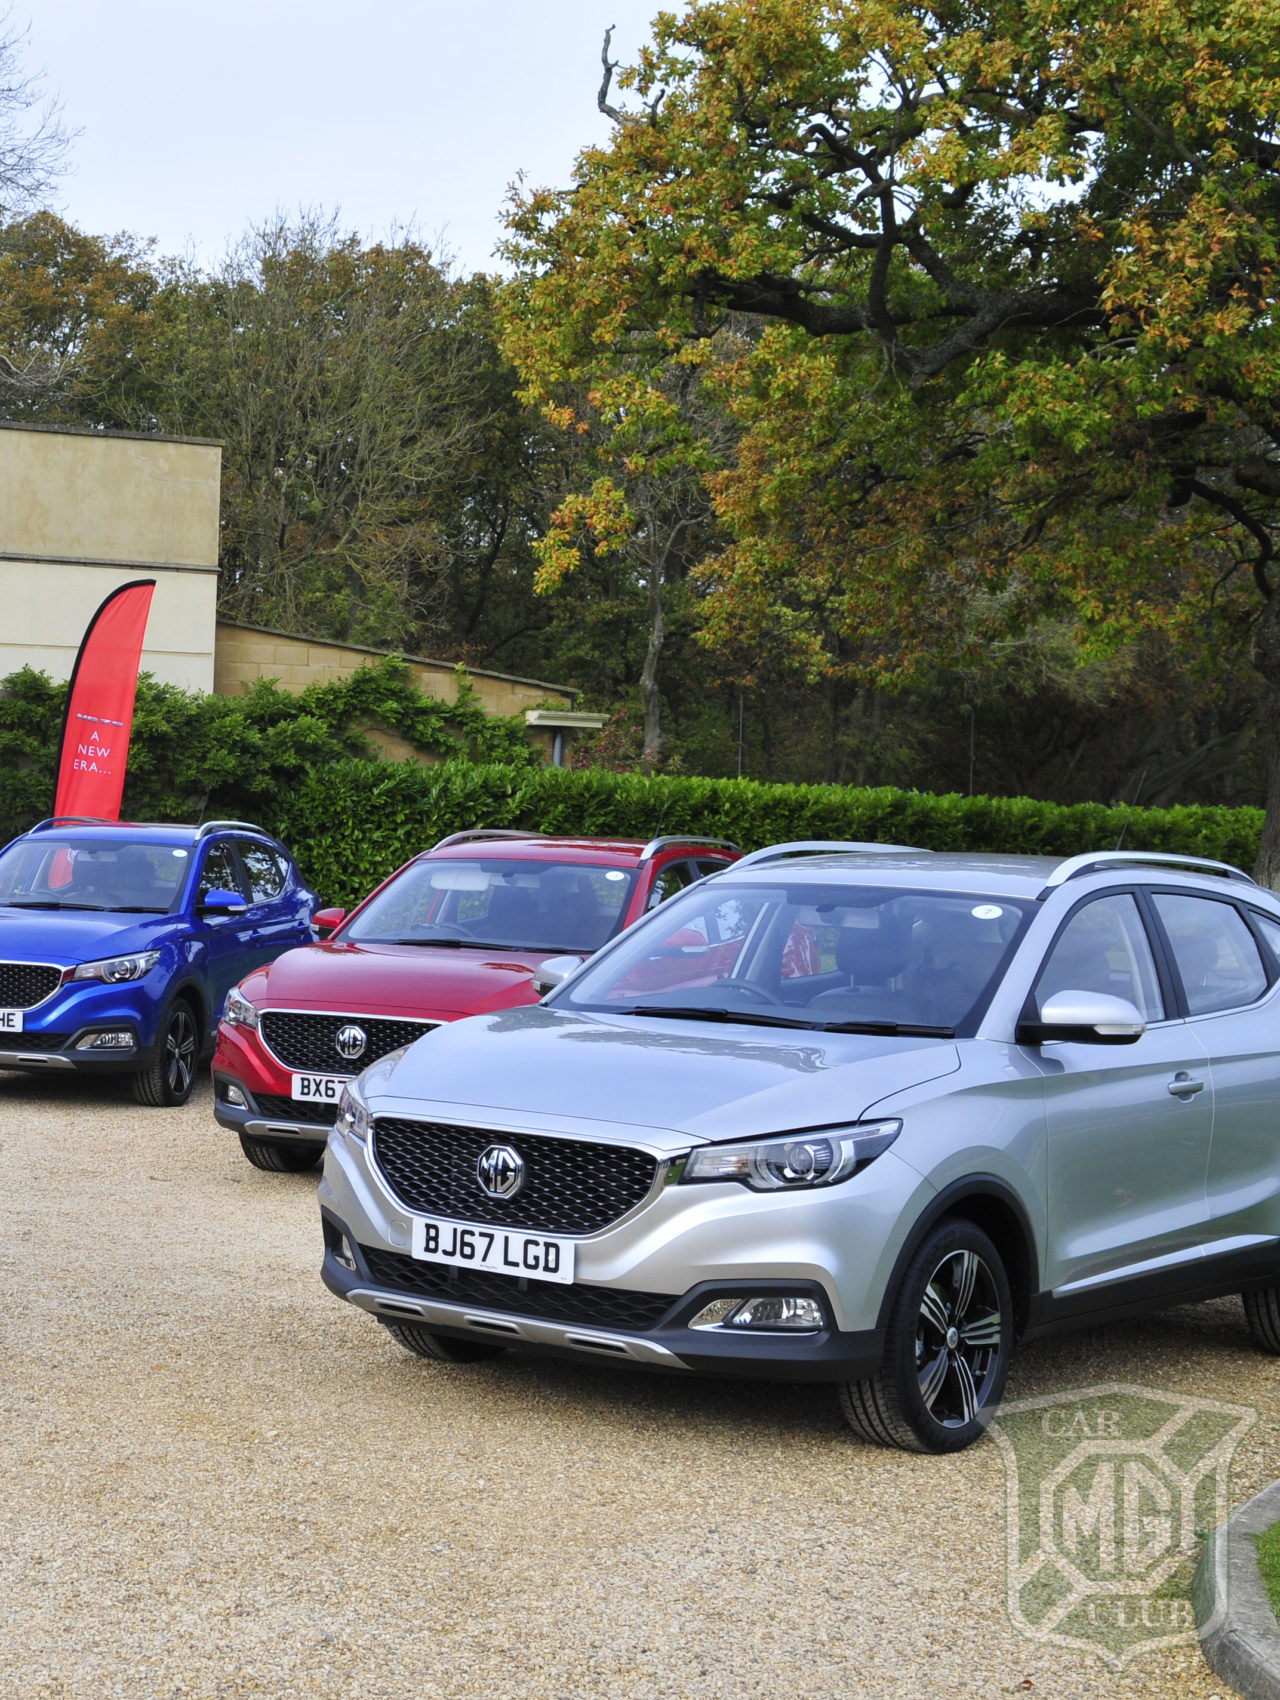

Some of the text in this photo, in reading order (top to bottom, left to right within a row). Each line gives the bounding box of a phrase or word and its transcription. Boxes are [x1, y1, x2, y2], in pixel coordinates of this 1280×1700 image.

[77, 743, 111, 759] NEW
[90, 730, 100, 742] A
[338, 1026, 365, 1056] MG
[478, 1146, 521, 1197] MG
[423, 1223, 561, 1274] BJ67 LGD
